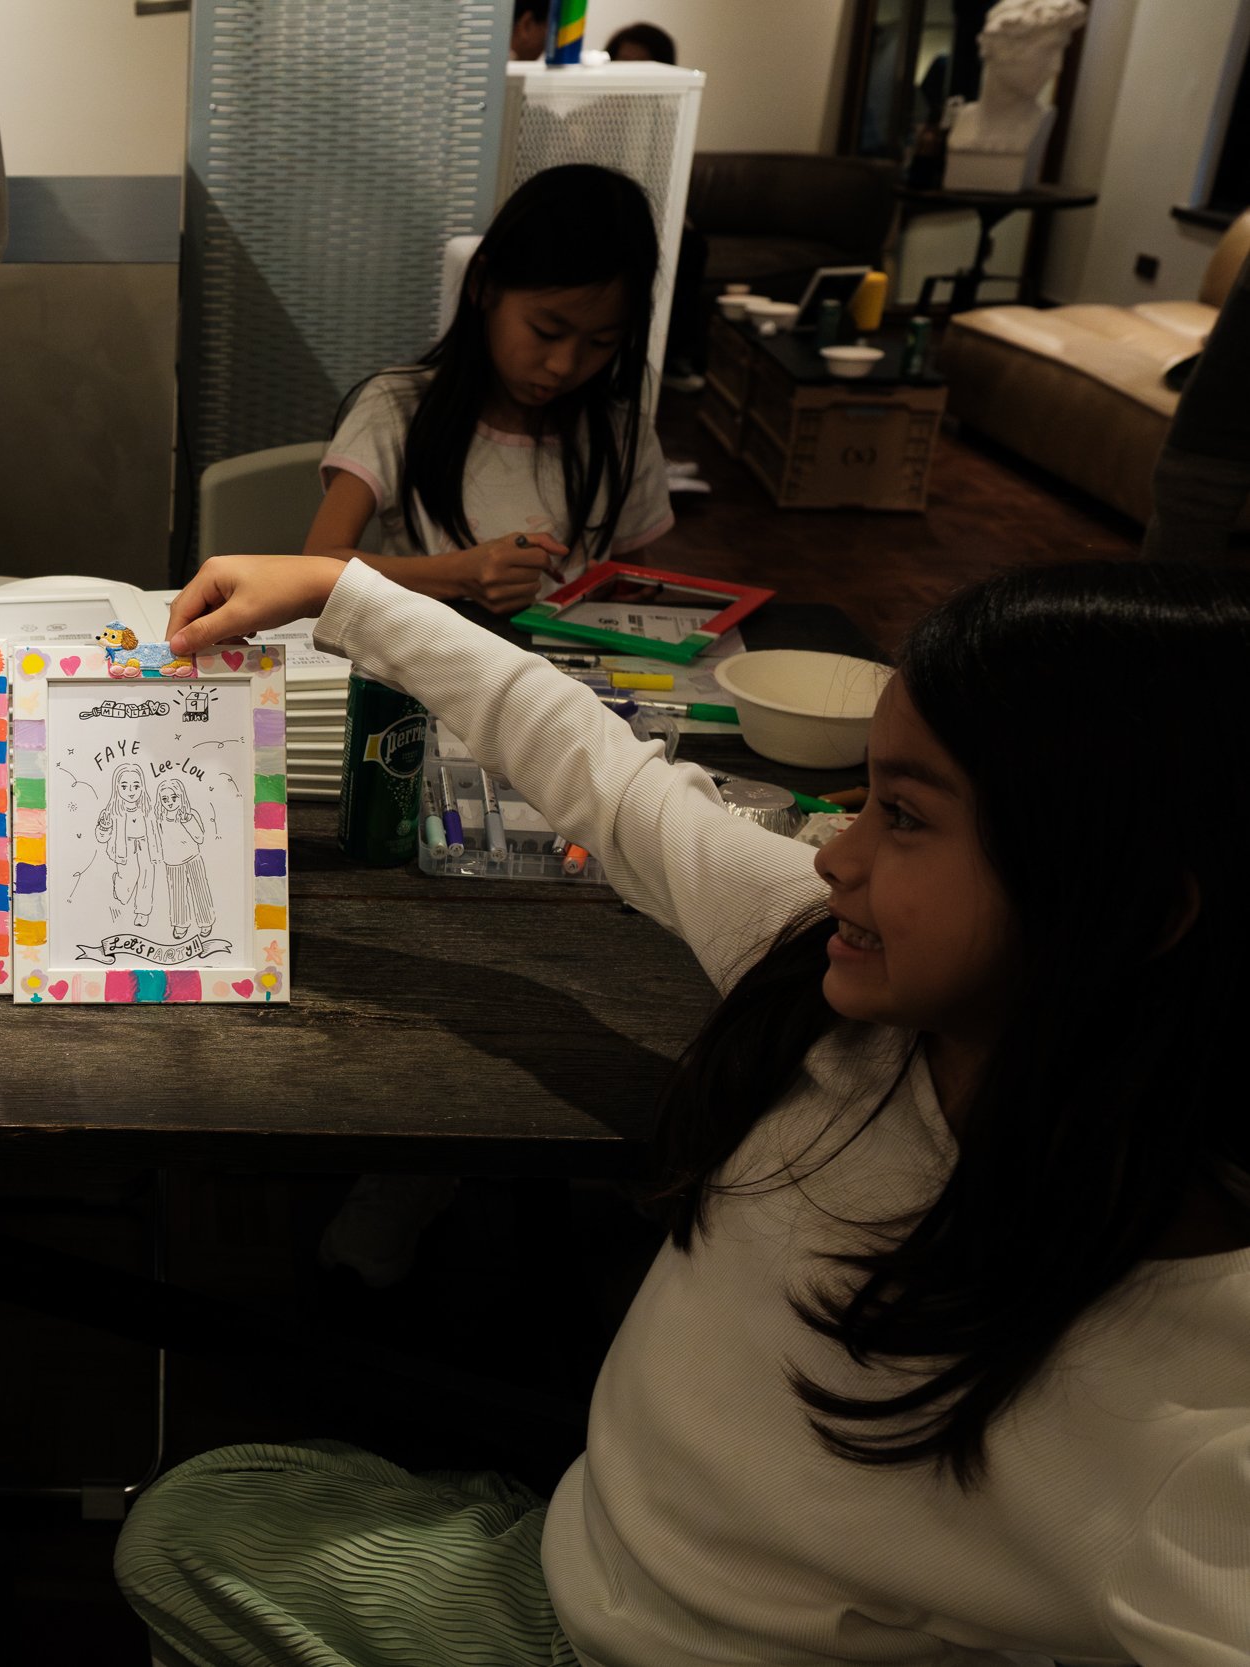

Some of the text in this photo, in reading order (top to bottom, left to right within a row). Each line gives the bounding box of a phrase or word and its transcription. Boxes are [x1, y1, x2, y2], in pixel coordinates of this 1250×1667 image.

[94, 739, 140, 771] FAYE
[150, 757, 207, 782] Lee-Lou
[109, 937, 146, 955] Let's
